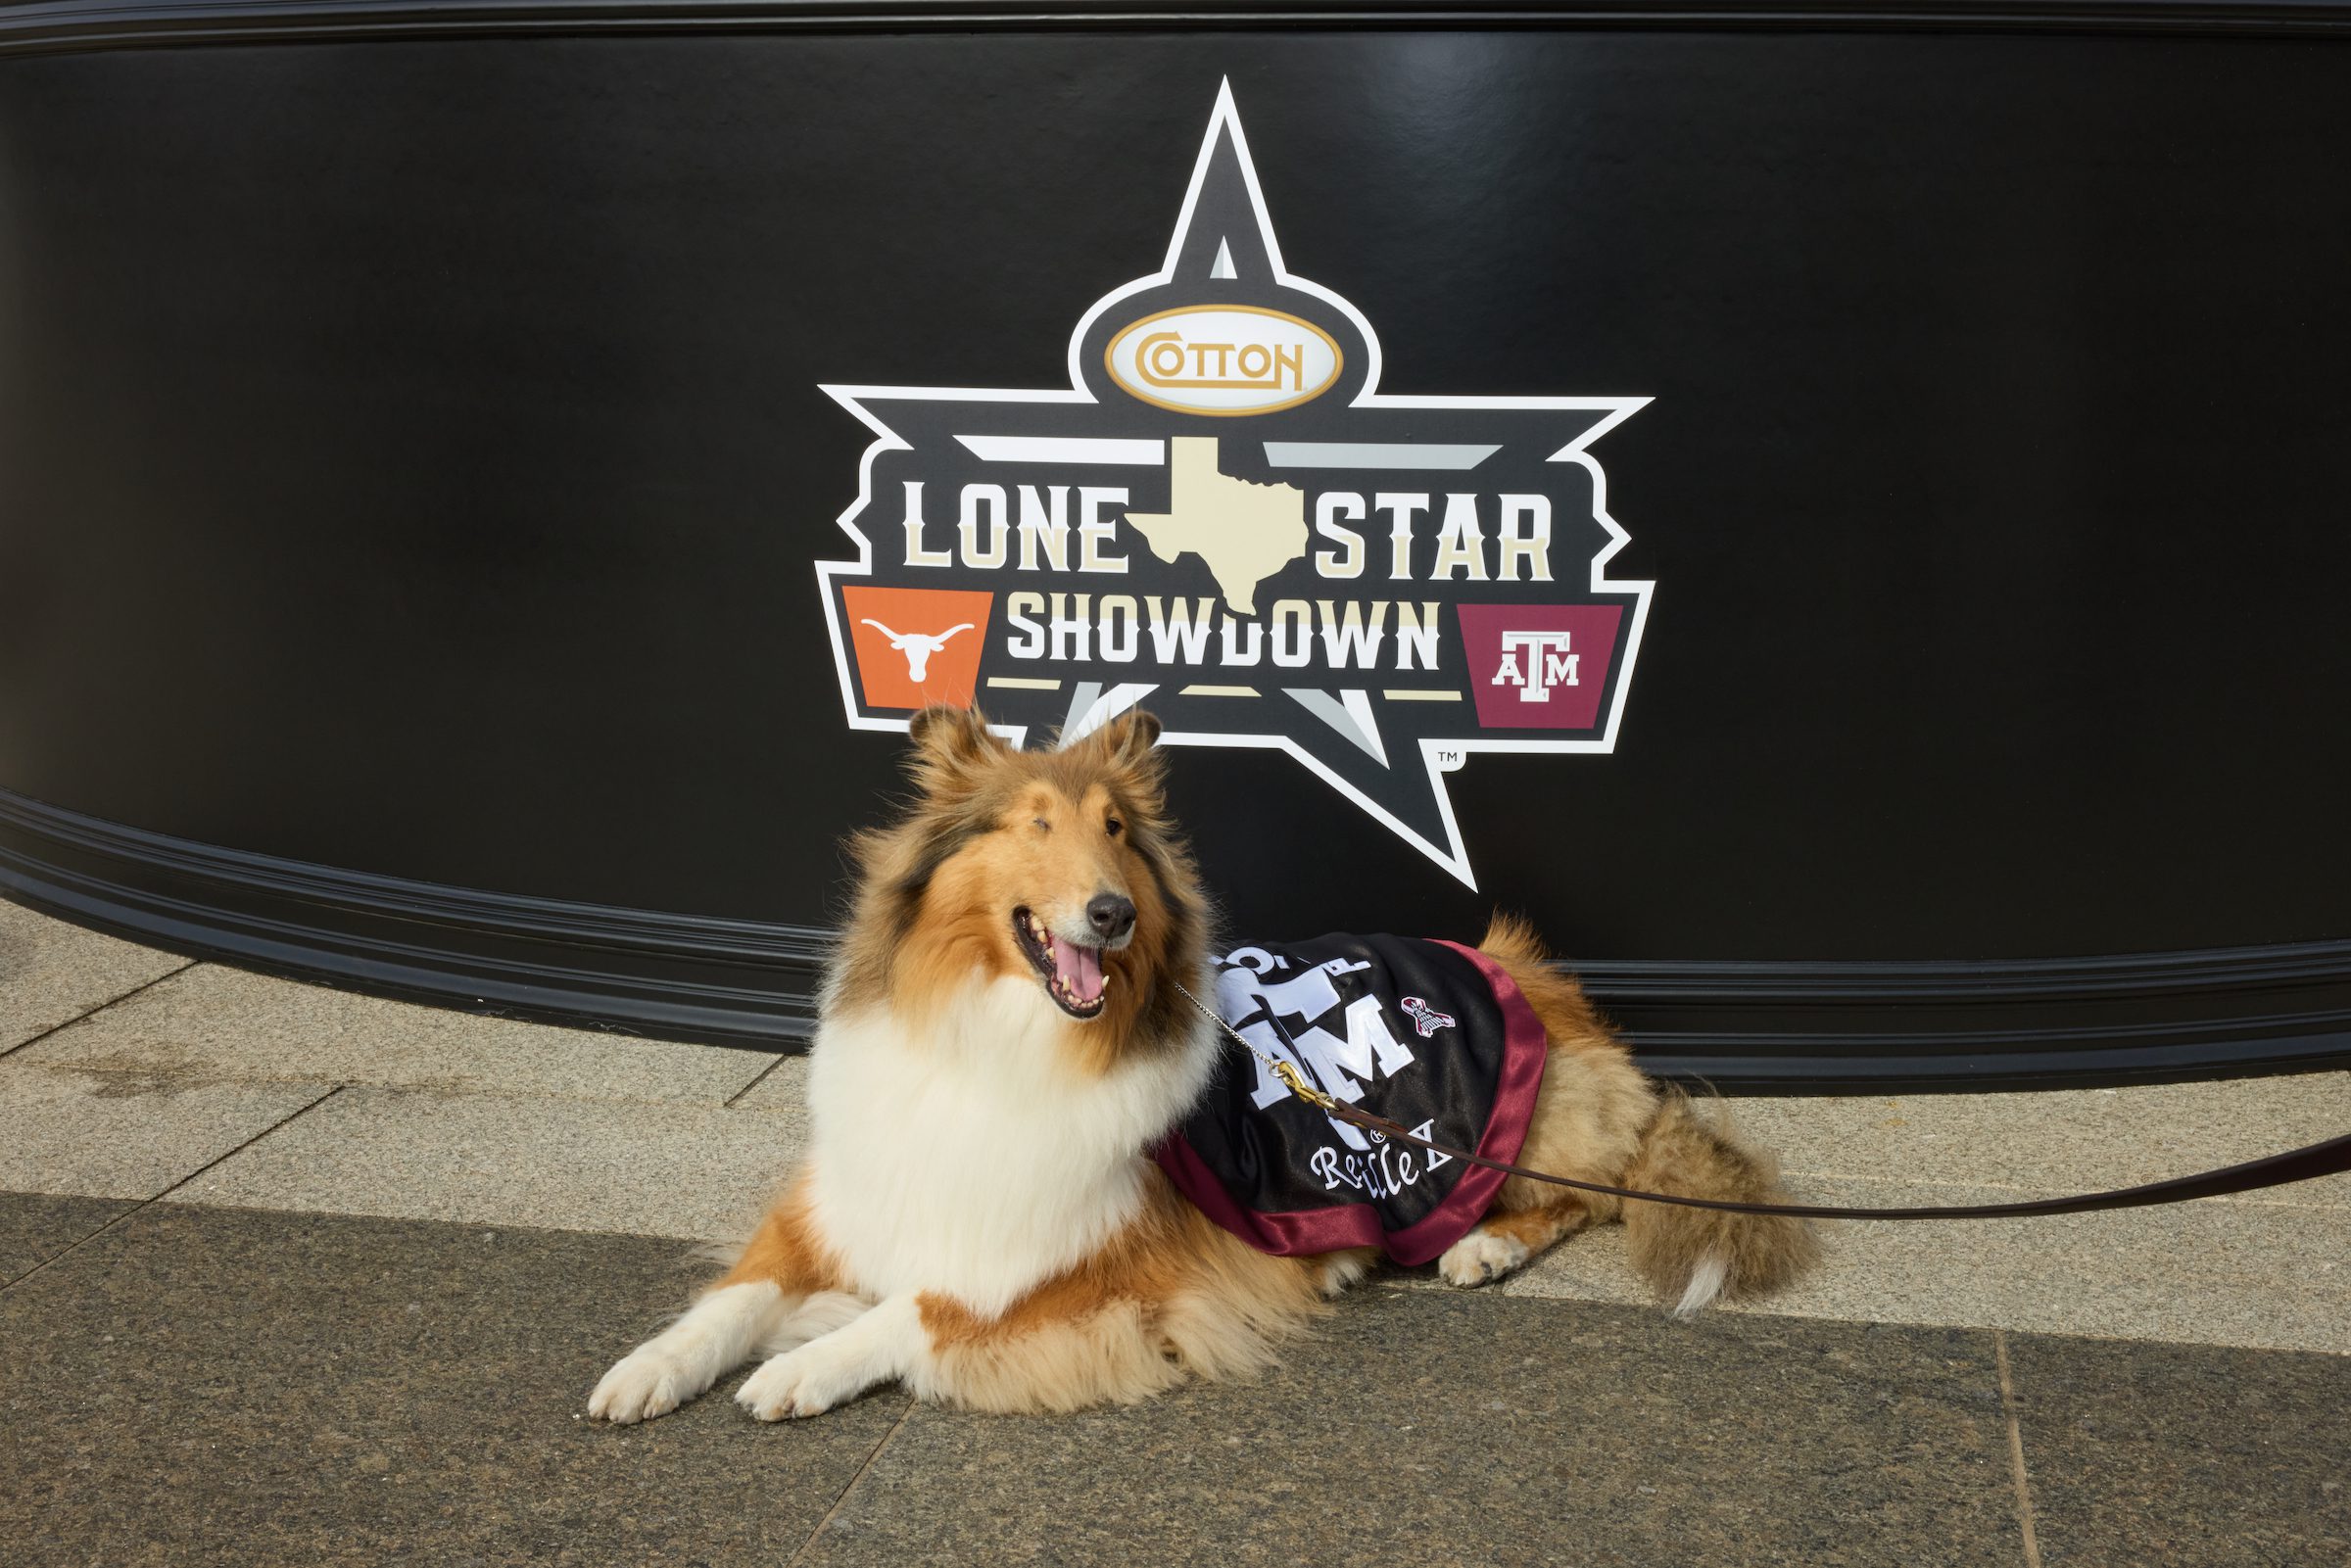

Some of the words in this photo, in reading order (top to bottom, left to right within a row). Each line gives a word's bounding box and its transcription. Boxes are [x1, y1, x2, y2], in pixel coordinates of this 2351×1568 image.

[1134, 330, 1304, 392] COTTON
[902, 481, 1129, 574] LONE
[1315, 491, 1556, 582] STAR
[1007, 591, 1442, 671] SHOWDOWN
